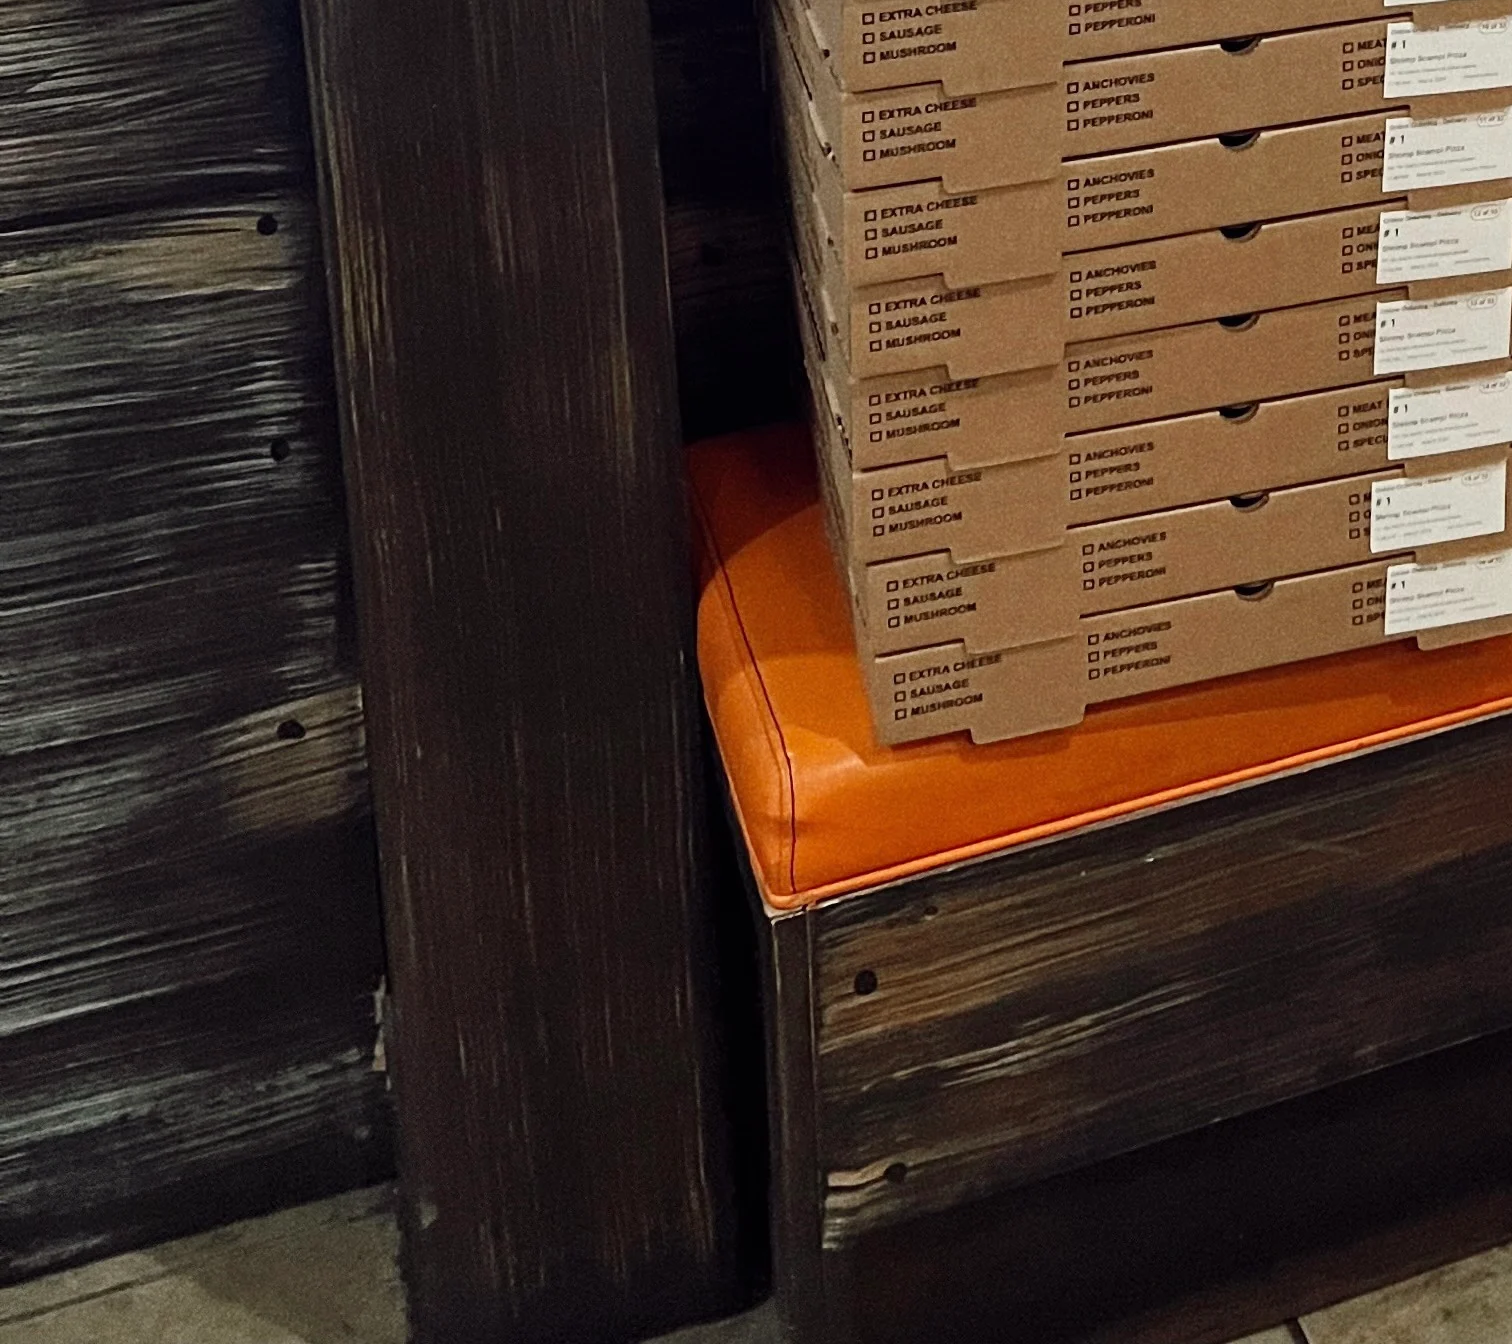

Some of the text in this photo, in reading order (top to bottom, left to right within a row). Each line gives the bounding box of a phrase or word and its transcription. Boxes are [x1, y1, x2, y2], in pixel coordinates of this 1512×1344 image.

[879, 2, 979, 22] EXTRA CHEESE
[1084, 13, 1155, 32] PEPPERONI
[880, 24, 942, 42] SAUSAGE
[880, 41, 956, 61] MUSHROOM
[1085, 260, 1157, 280] ANCHOVIES
[1086, 281, 1142, 298] PEPPERS
[885, 290, 982, 312] EXTRA CHEESE
[1085, 296, 1155, 316] PEPPERONI
[884, 312, 947, 331] SAUSAGE
[886, 328, 961, 349] MUSHROOM
[1103, 621, 1172, 642] ANCHOVIES
[1103, 641, 1157, 660] PEPPERS
[909, 656, 1003, 682] EXTRA CHEESE
[1103, 655, 1172, 677] PEPPERONI
[908, 678, 969, 701] SAUSAGE
[911, 693, 983, 717] MUSHROOM
